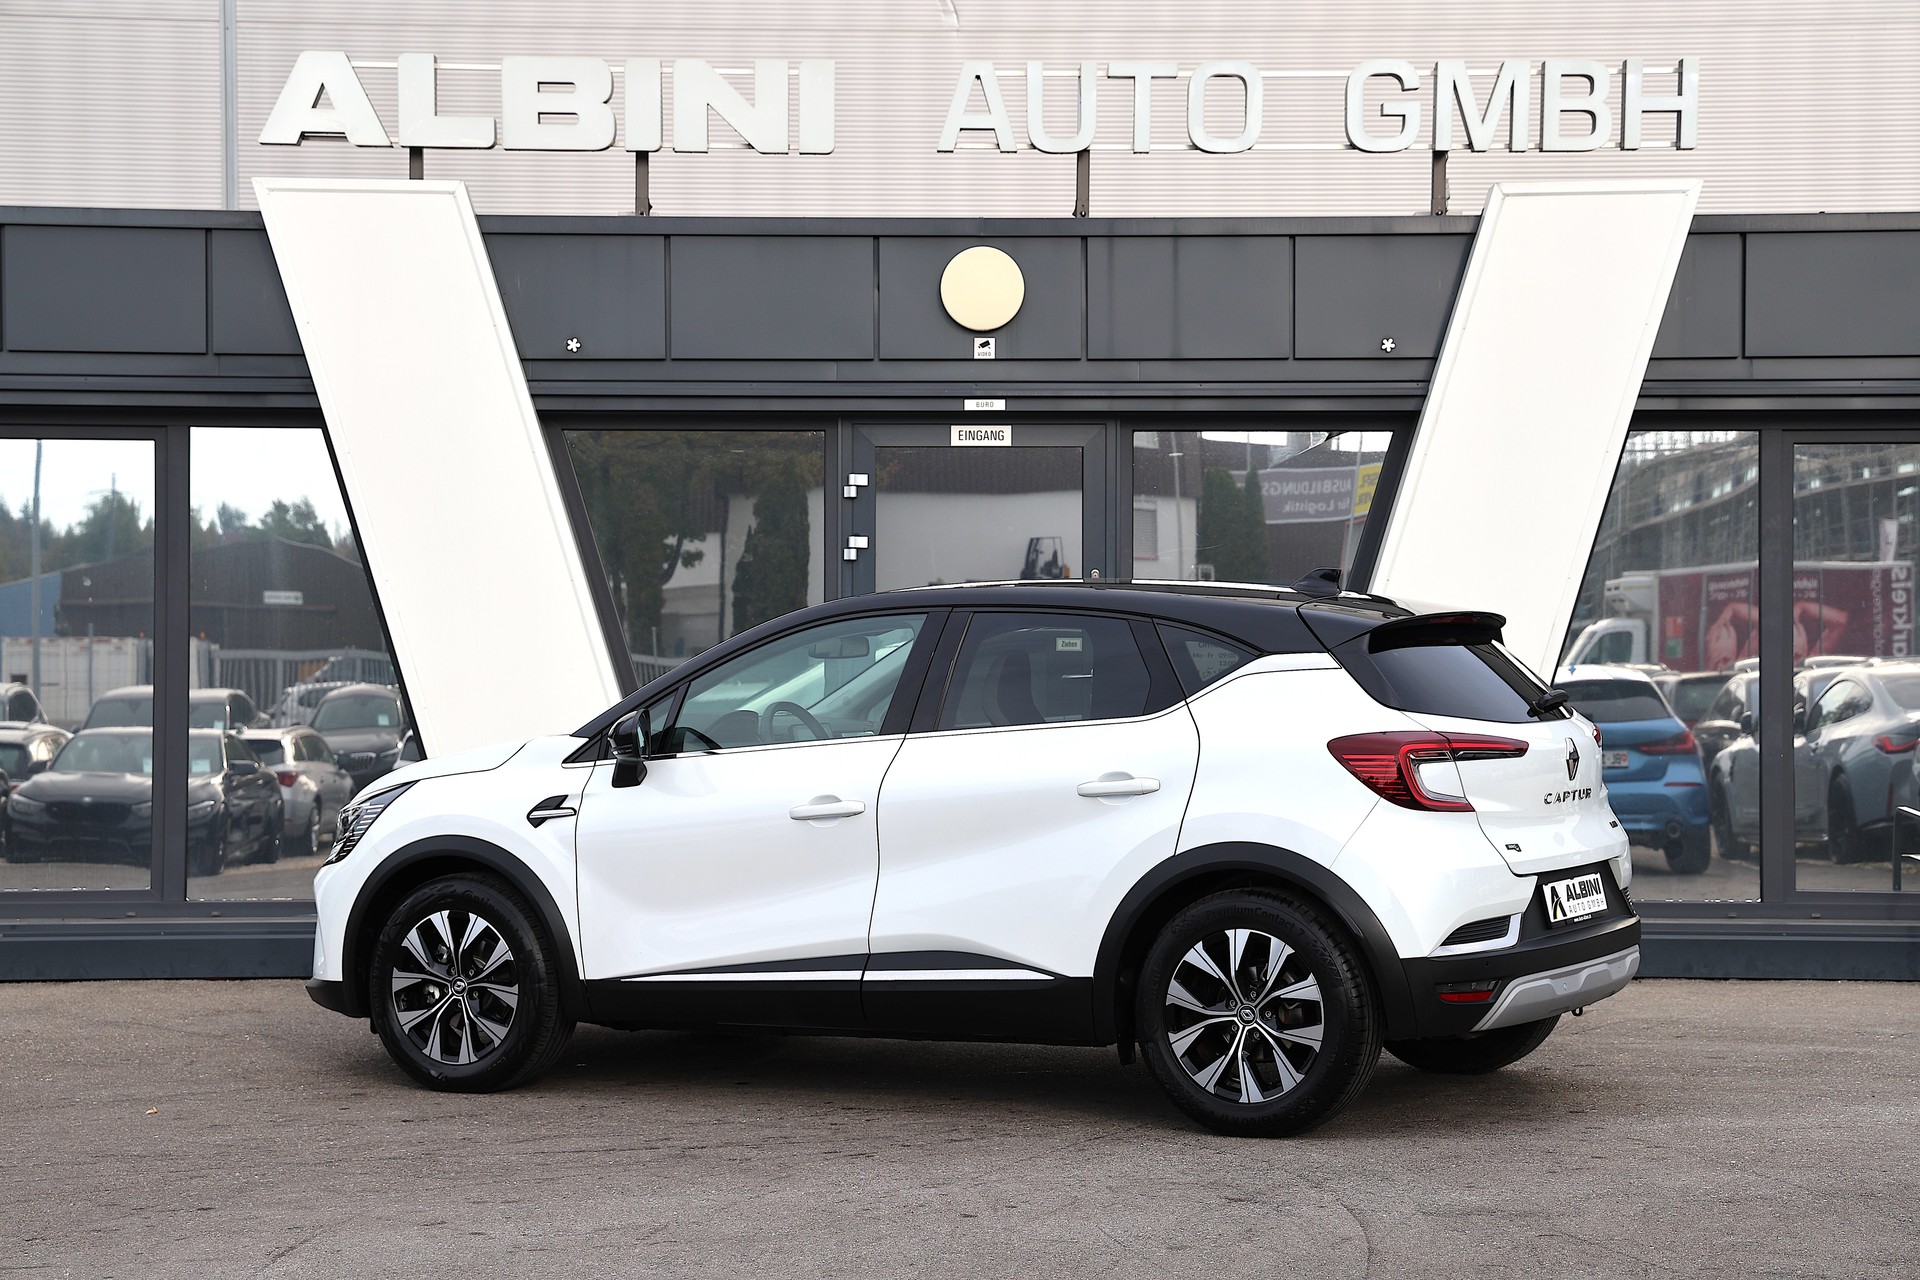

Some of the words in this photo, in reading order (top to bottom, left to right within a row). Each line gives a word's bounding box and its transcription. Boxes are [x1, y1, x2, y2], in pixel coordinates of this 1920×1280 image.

[257, 51, 836, 155] ALBINI
[936, 58, 1264, 154] AUTO
[1345, 57, 1700, 153] GMBH
[958, 430, 1005, 441] EINGANG
[1061, 640, 1078, 648] Ziehen
[1544, 788, 1592, 805] CAPTUR
[1566, 878, 1602, 902] ALBINI
[1569, 901, 1586, 914] AUTO
[1587, 897, 1605, 910] GMBH
[1205, 904, 1296, 931] PremiumContact
